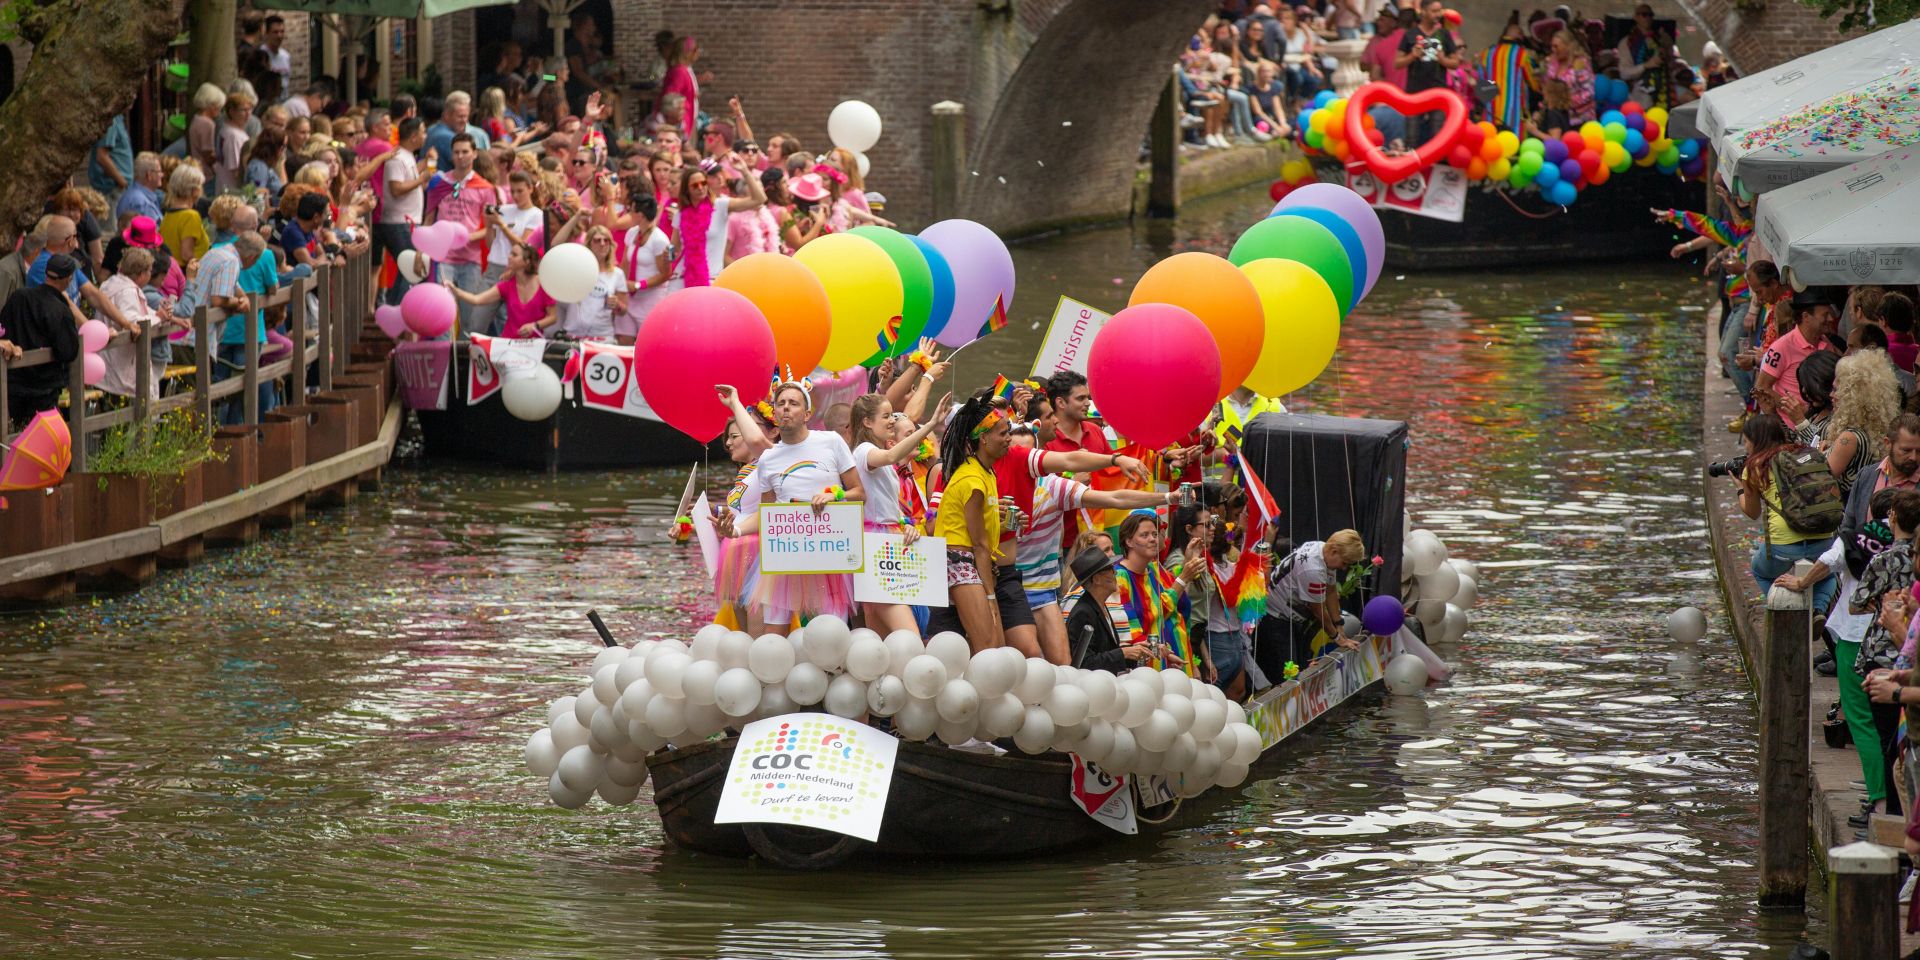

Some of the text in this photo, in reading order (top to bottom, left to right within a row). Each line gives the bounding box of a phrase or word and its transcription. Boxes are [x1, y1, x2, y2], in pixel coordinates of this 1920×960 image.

[1823, 257, 1903, 267] ANNO 1276
[1764, 348, 1782, 369] 52
[590, 362, 620, 384] 30
[767, 511, 771, 523] I
[774, 510, 811, 523] make
[767, 522, 844, 537] apologies...
[767, 537, 850, 553] This is me!
[750, 772, 854, 790] Midden-Nederland
[761, 794, 795, 806] Durf
[815, 793, 854, 803] leven!
